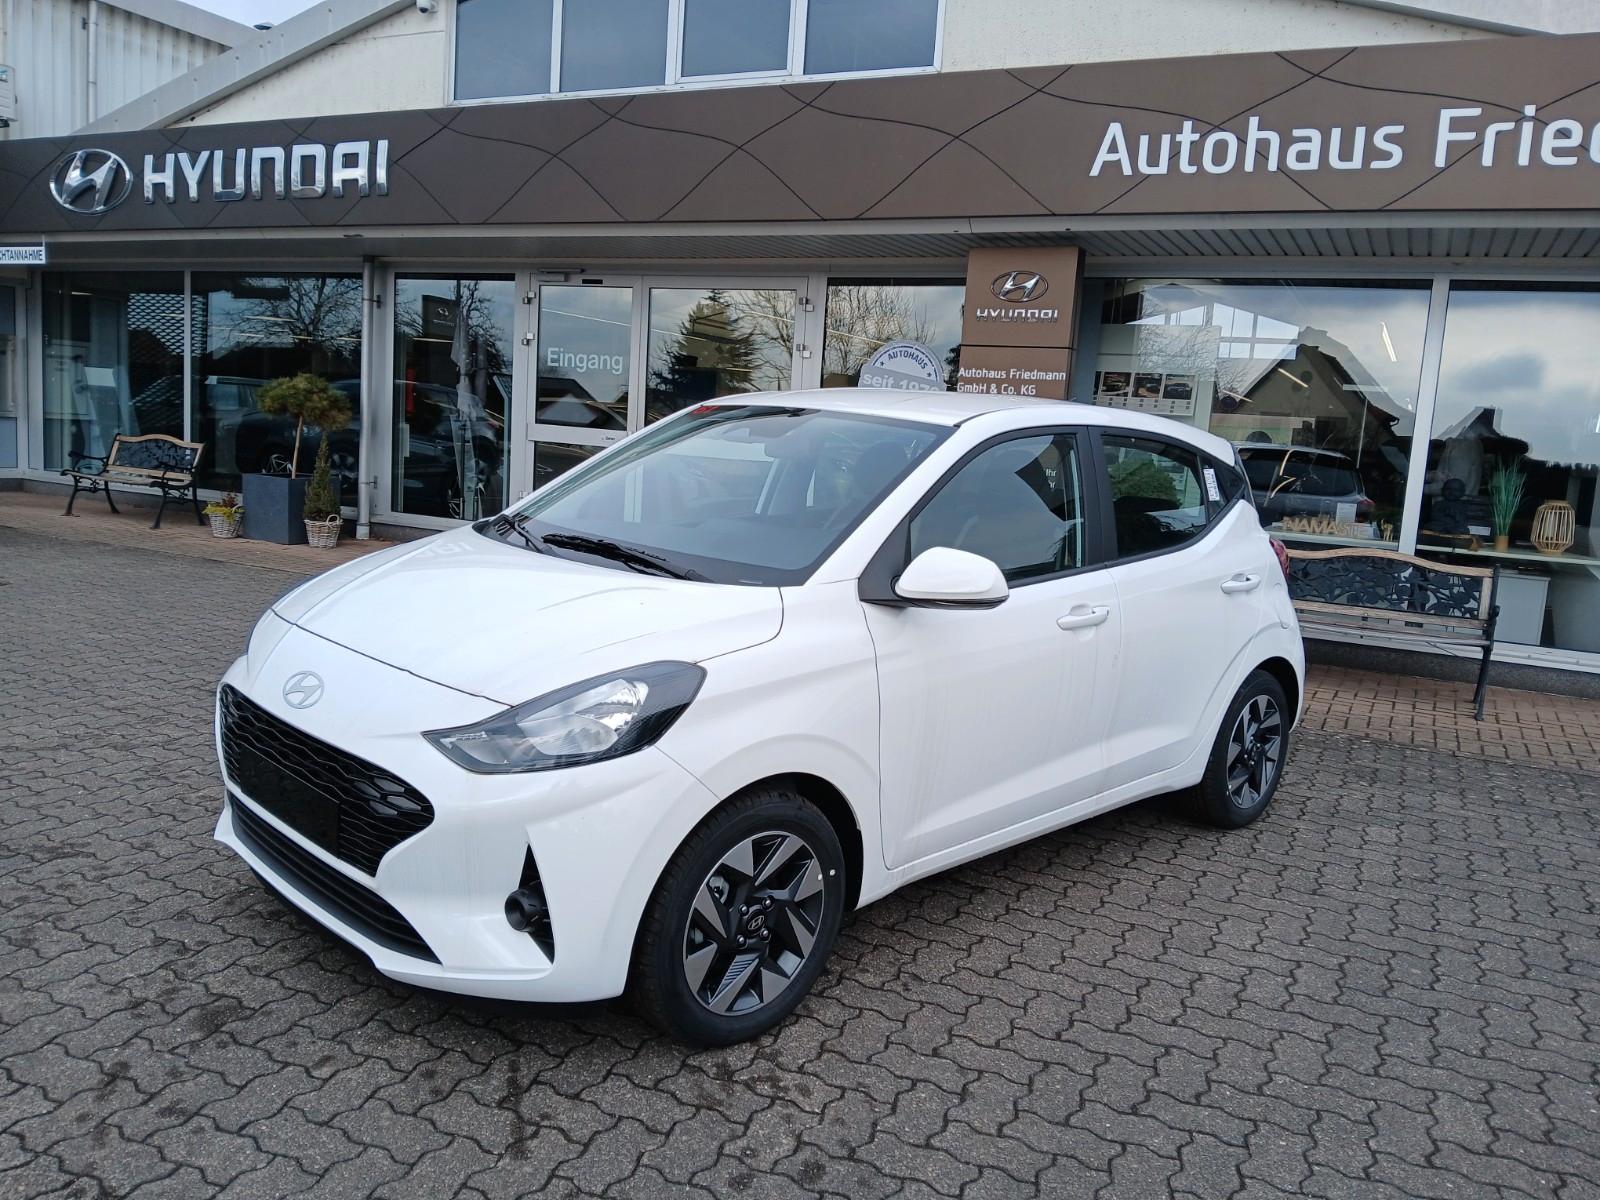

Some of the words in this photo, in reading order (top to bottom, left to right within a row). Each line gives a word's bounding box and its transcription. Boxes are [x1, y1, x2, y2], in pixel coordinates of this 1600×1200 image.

[1089, 116, 1405, 177] Autohaus
[143, 139, 389, 205] HYUNDAI
[0, 249, 43, 261] HTANNAHME
[976, 308, 1058, 323] HYUNDAI
[547, 347, 624, 375] Eingang
[888, 349, 929, 370] AUTOHAUS
[862, 373, 895, 389] seit
[899, 379, 940, 392] 19
[958, 367, 1007, 379] Autohaus
[1010, 368, 1066, 381] Friedmann
[957, 382, 987, 394] GmbH
[990, 384, 998, 394] &
[1001, 384, 1017, 395] Co.
[1021, 384, 1037, 396] KG
